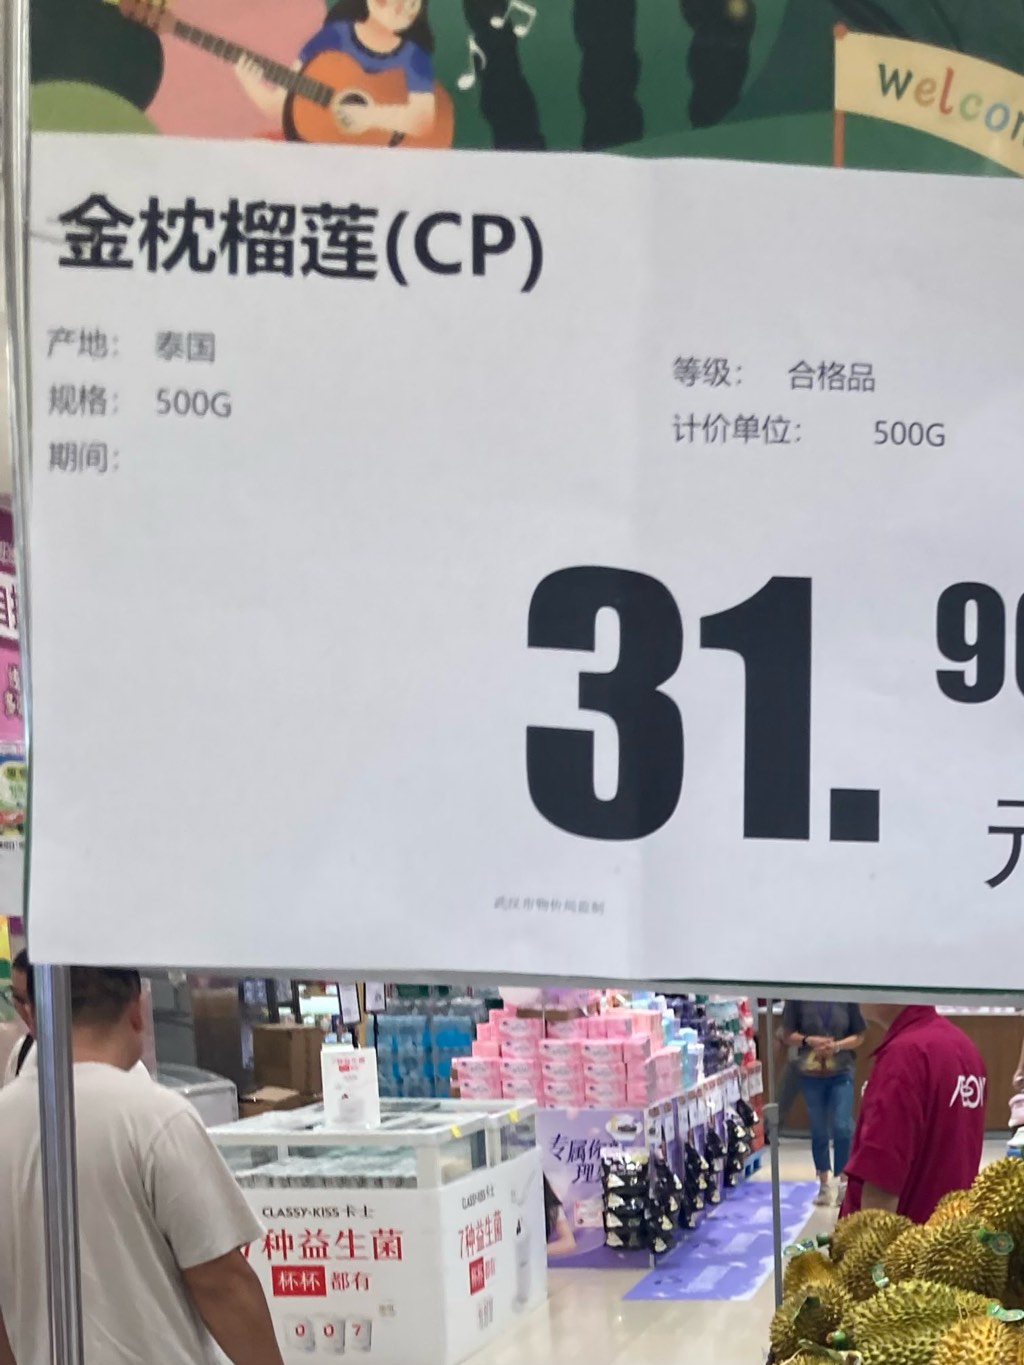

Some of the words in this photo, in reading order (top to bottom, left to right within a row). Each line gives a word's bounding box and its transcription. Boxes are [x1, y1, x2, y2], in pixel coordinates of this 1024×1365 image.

[57, 193, 544, 294] 金枕榴莲(CP)
[46, 327, 119, 362] 产地：
[156, 330, 216, 363] 泰国
[672, 356, 743, 388] 等级：
[787, 361, 876, 393] 合格品
[48, 384, 119, 418] 规格：
[156, 389, 232, 419] 500G
[672, 414, 802, 445] 计价单位：
[873, 420, 946, 448] 500G
[48, 442, 119, 473] 期间：
